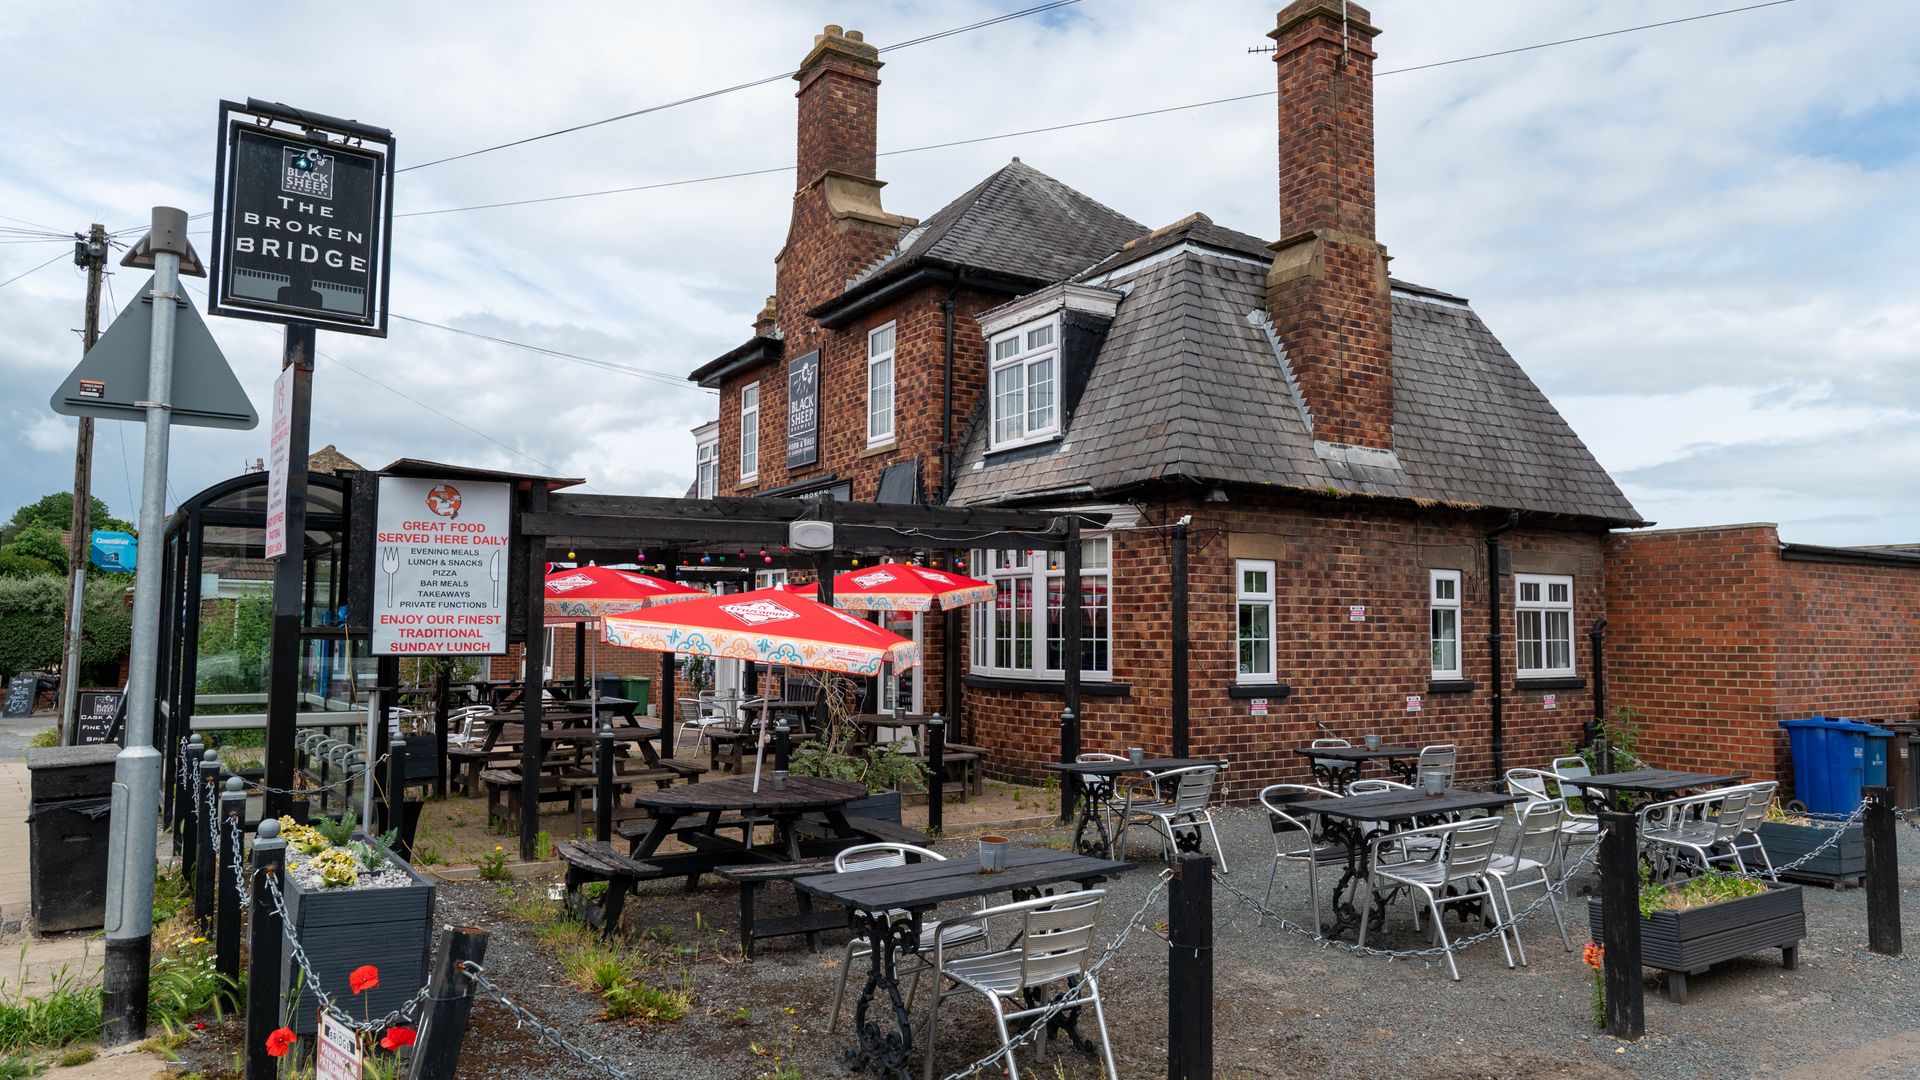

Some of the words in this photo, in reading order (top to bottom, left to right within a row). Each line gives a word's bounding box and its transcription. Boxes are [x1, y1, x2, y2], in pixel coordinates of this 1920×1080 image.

[287, 166, 328, 183] BLACK
[286, 176, 328, 191] SHEEP
[278, 195, 334, 218] THE
[244, 212, 363, 244] BROKEN
[236, 237, 367, 273] BRIDGE
[792, 395, 814, 414] BLACK
[791, 409, 814, 427] SHEEP
[402, 521, 446, 531] GREAT
[450, 523, 486, 533] FOOD
[378, 533, 429, 544] SERVED
[434, 535, 468, 544] HERE
[473, 536, 508, 546] DAILY
[411, 548, 449, 556] EVENING
[440, 580, 469, 588] MEALS
[438, 601, 487, 609] FUNCTIONS
[380, 614, 424, 625] ENJOY
[426, 614, 454, 625] OUR
[457, 615, 501, 625] FINEST
[398, 628, 484, 638] TRADITIONAL
[390, 642, 444, 652] SUNDAY
[446, 642, 490, 652] LUNCH
[330, 1031, 350, 1052] BRIDGE
